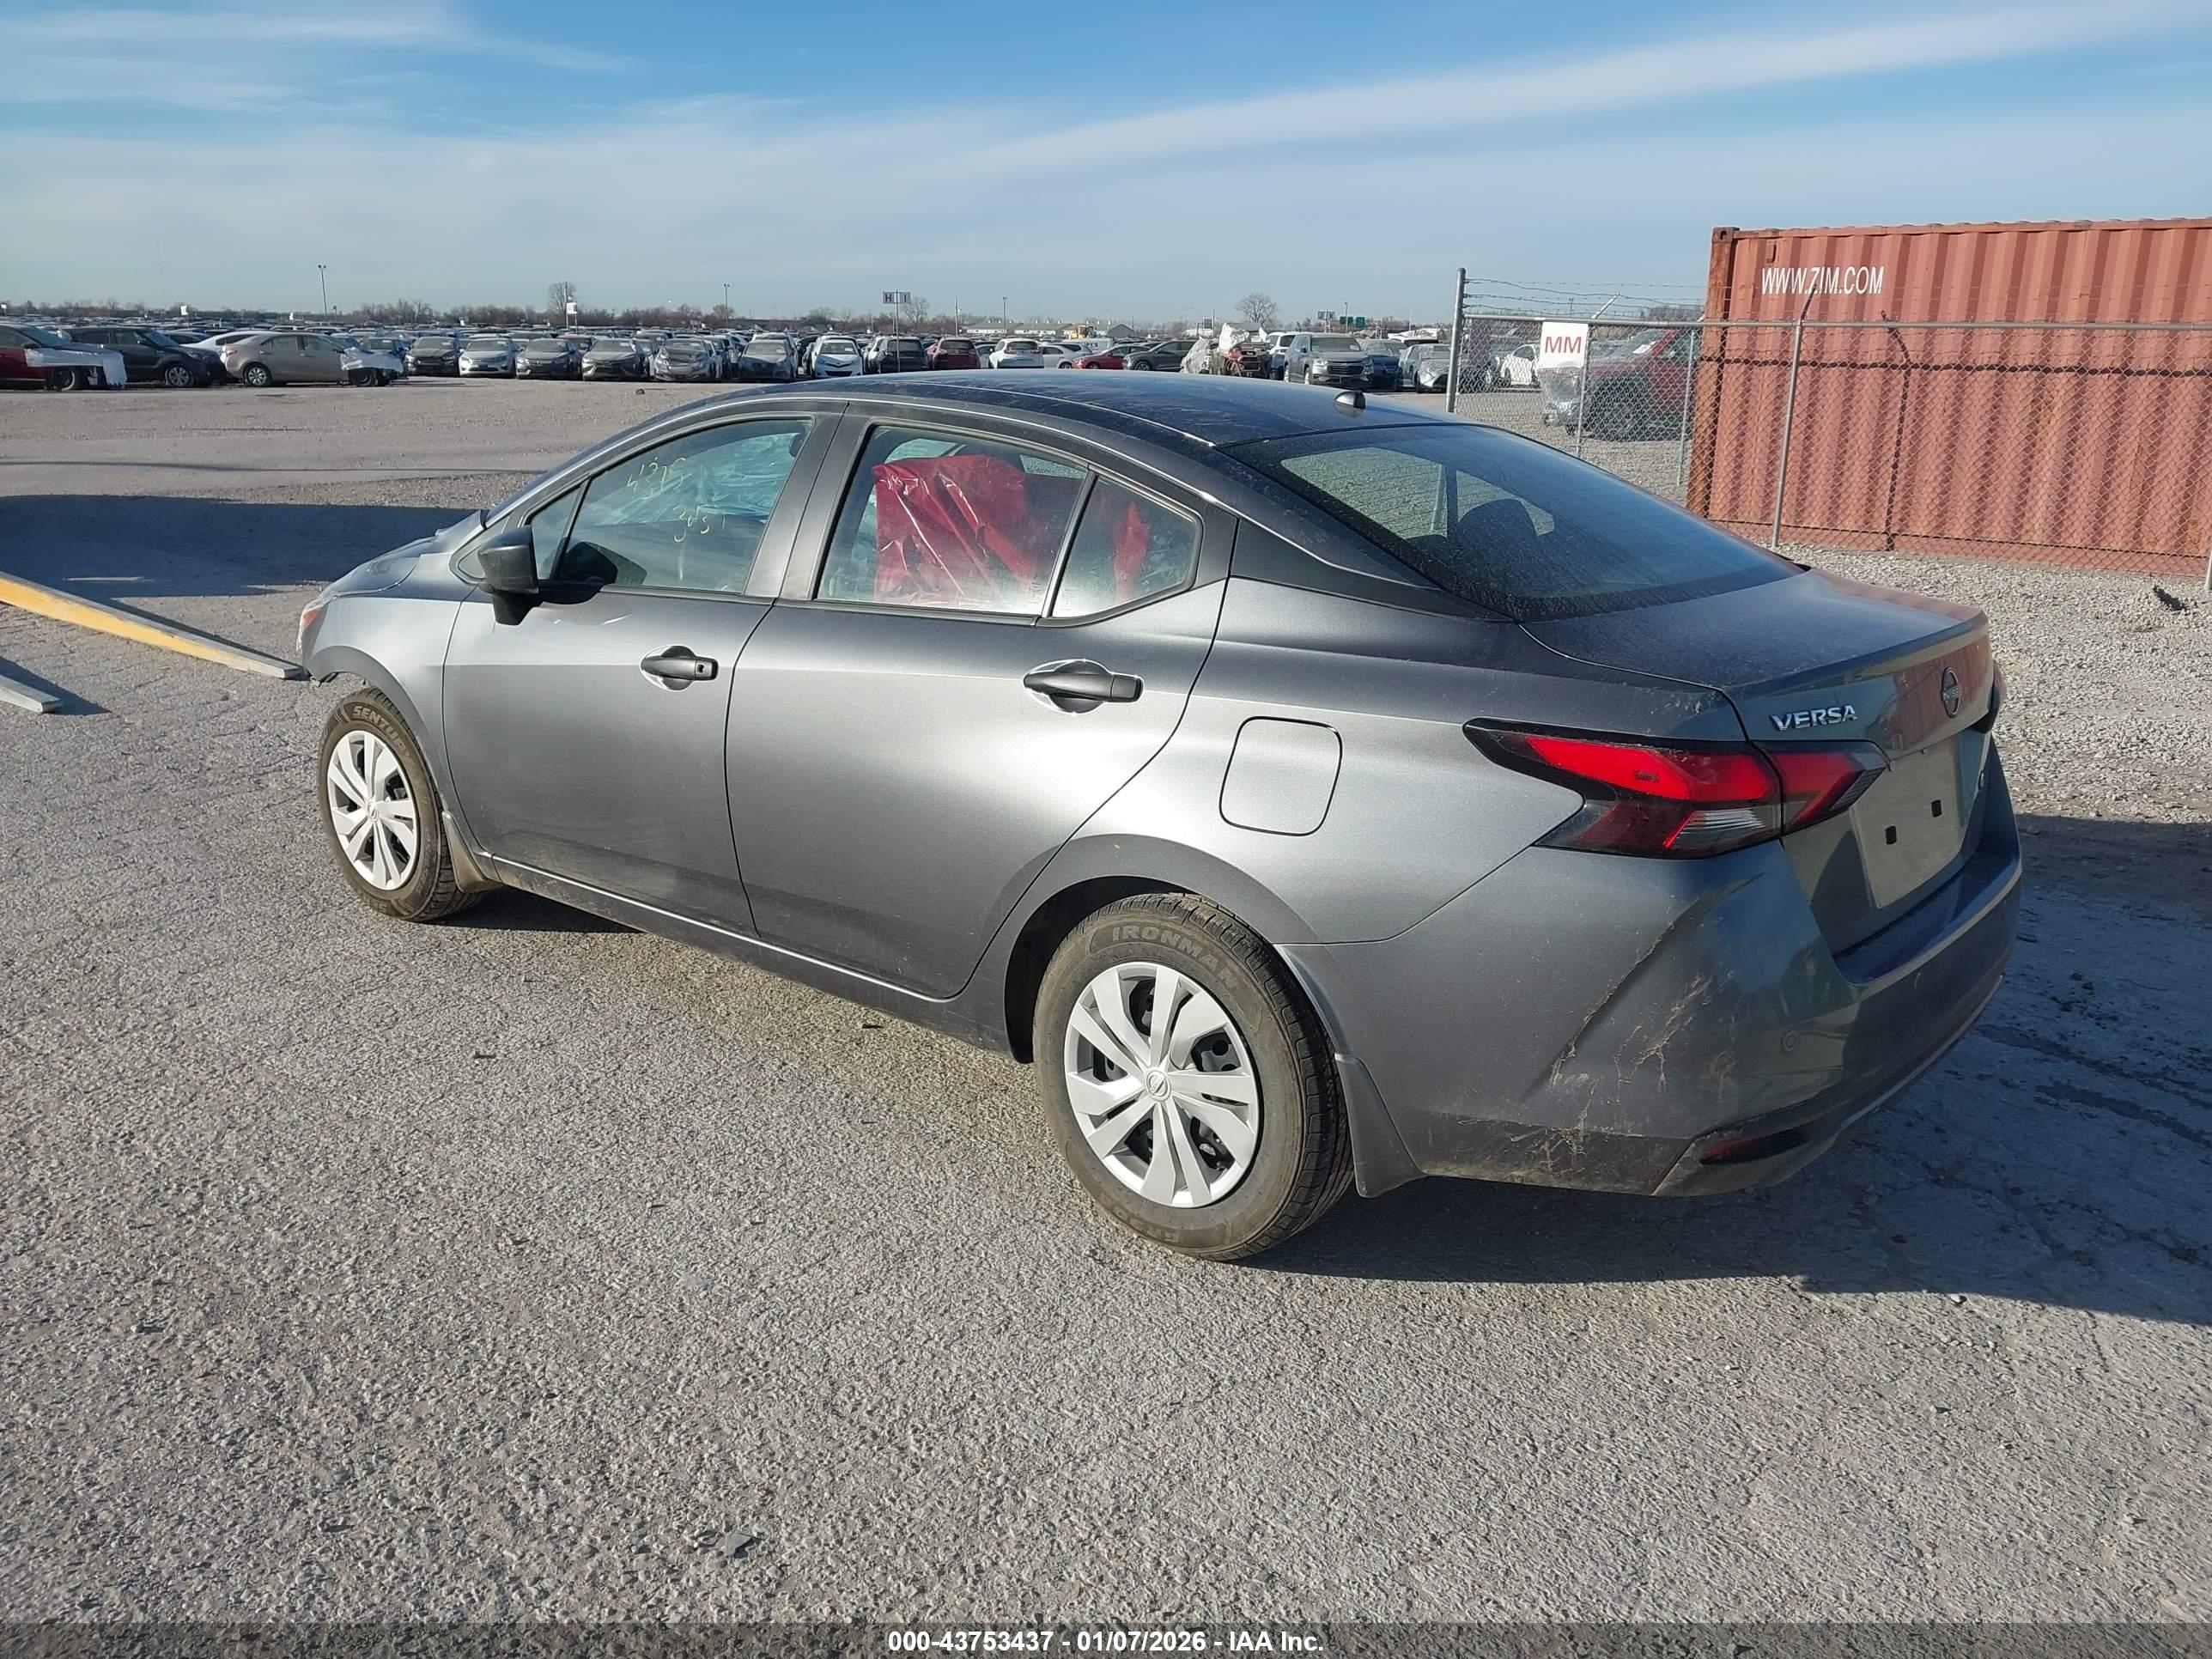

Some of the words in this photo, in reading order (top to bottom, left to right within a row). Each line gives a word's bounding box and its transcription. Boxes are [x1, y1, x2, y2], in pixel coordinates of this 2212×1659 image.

[1761, 266, 1885, 295] WWW.ZIM.COM
[1545, 336, 1582, 354] MM
[1769, 704, 1858, 731] VERSA
[1112, 925, 1240, 989] IRONMAN
